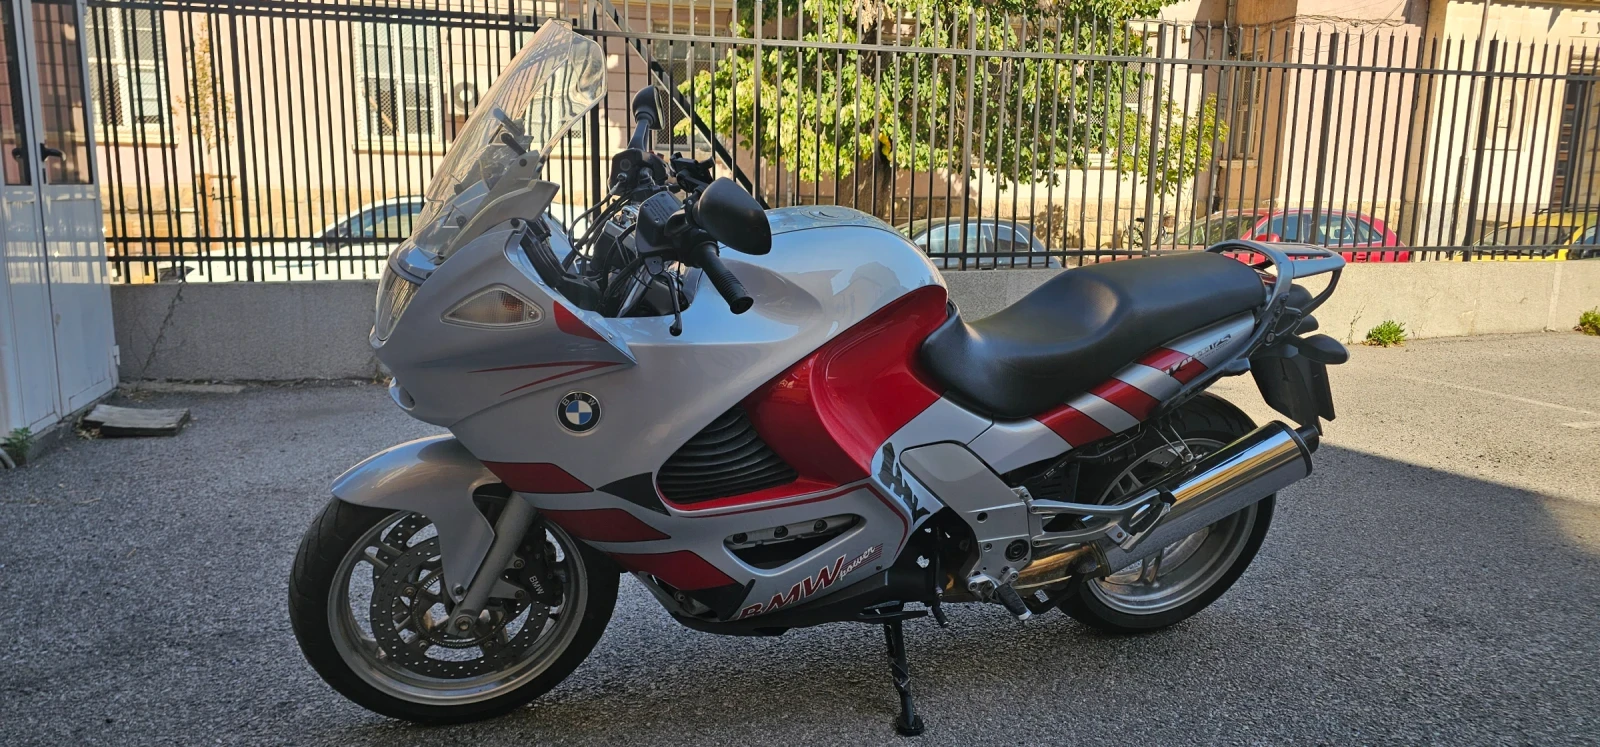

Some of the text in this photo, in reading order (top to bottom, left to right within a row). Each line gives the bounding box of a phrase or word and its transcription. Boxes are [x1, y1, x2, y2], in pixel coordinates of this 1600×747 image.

[562, 393, 597, 406] BMW
[529, 575, 545, 595] BMW
[738, 546, 875, 620] BMW power
